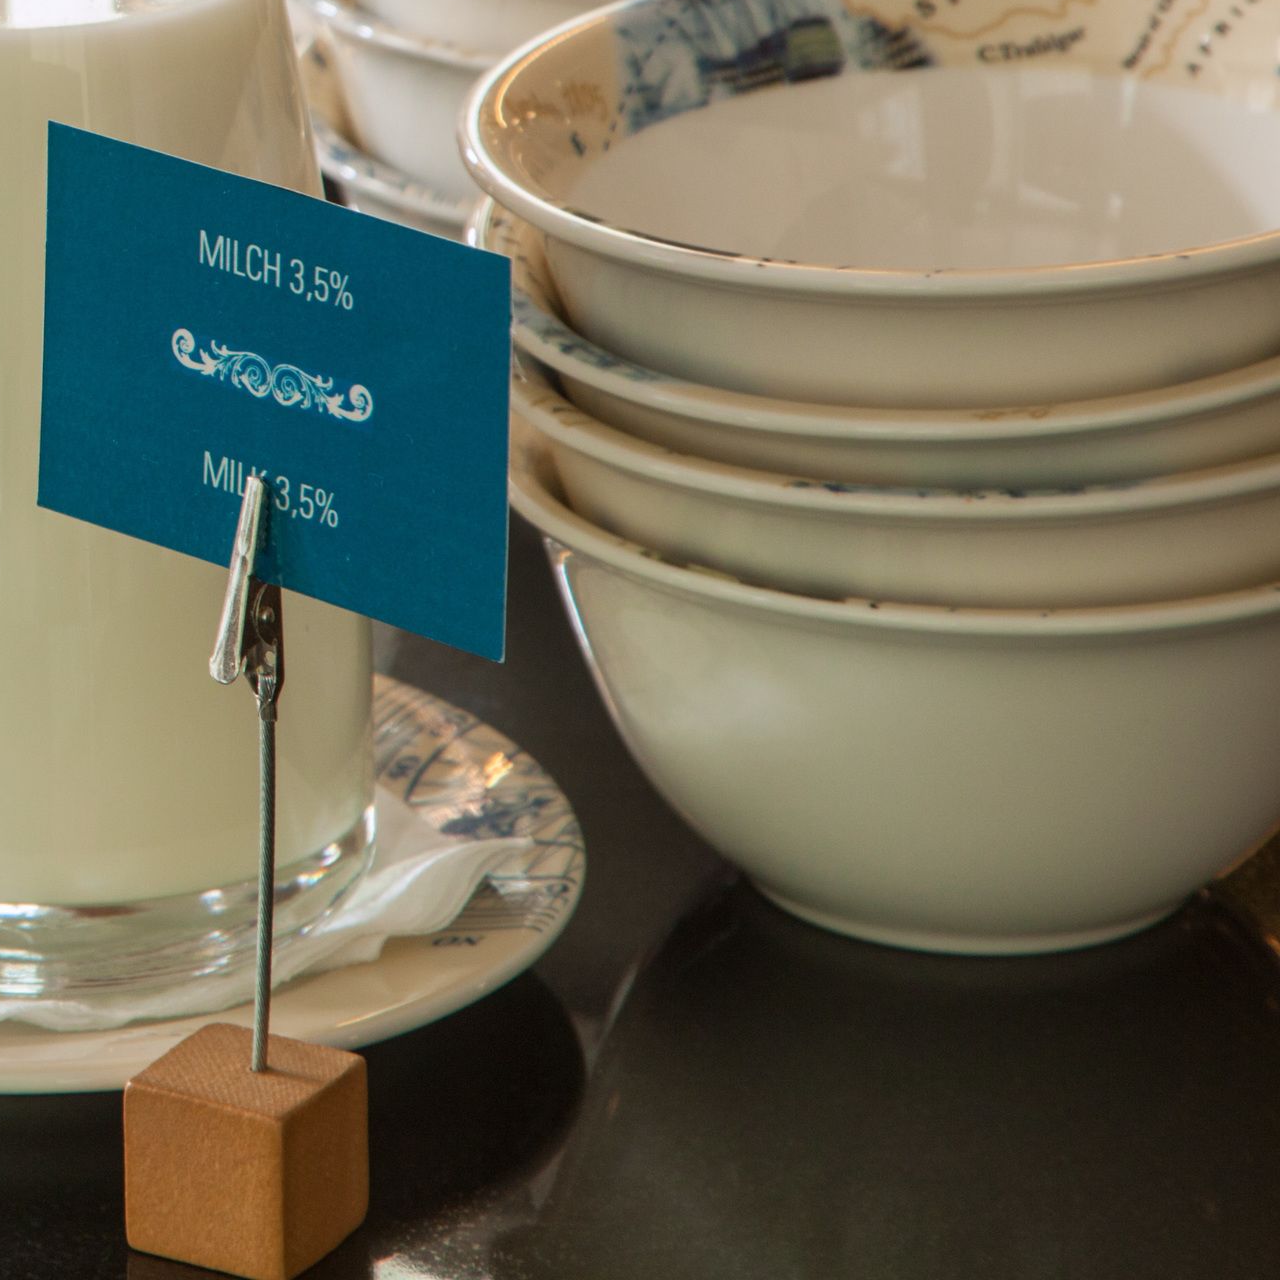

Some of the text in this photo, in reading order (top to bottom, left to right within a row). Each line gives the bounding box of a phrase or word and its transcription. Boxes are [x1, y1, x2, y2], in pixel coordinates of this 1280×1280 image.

[199, 229, 354, 310] MILCH 3,5%
[203, 450, 339, 528] MIL 3,5%
